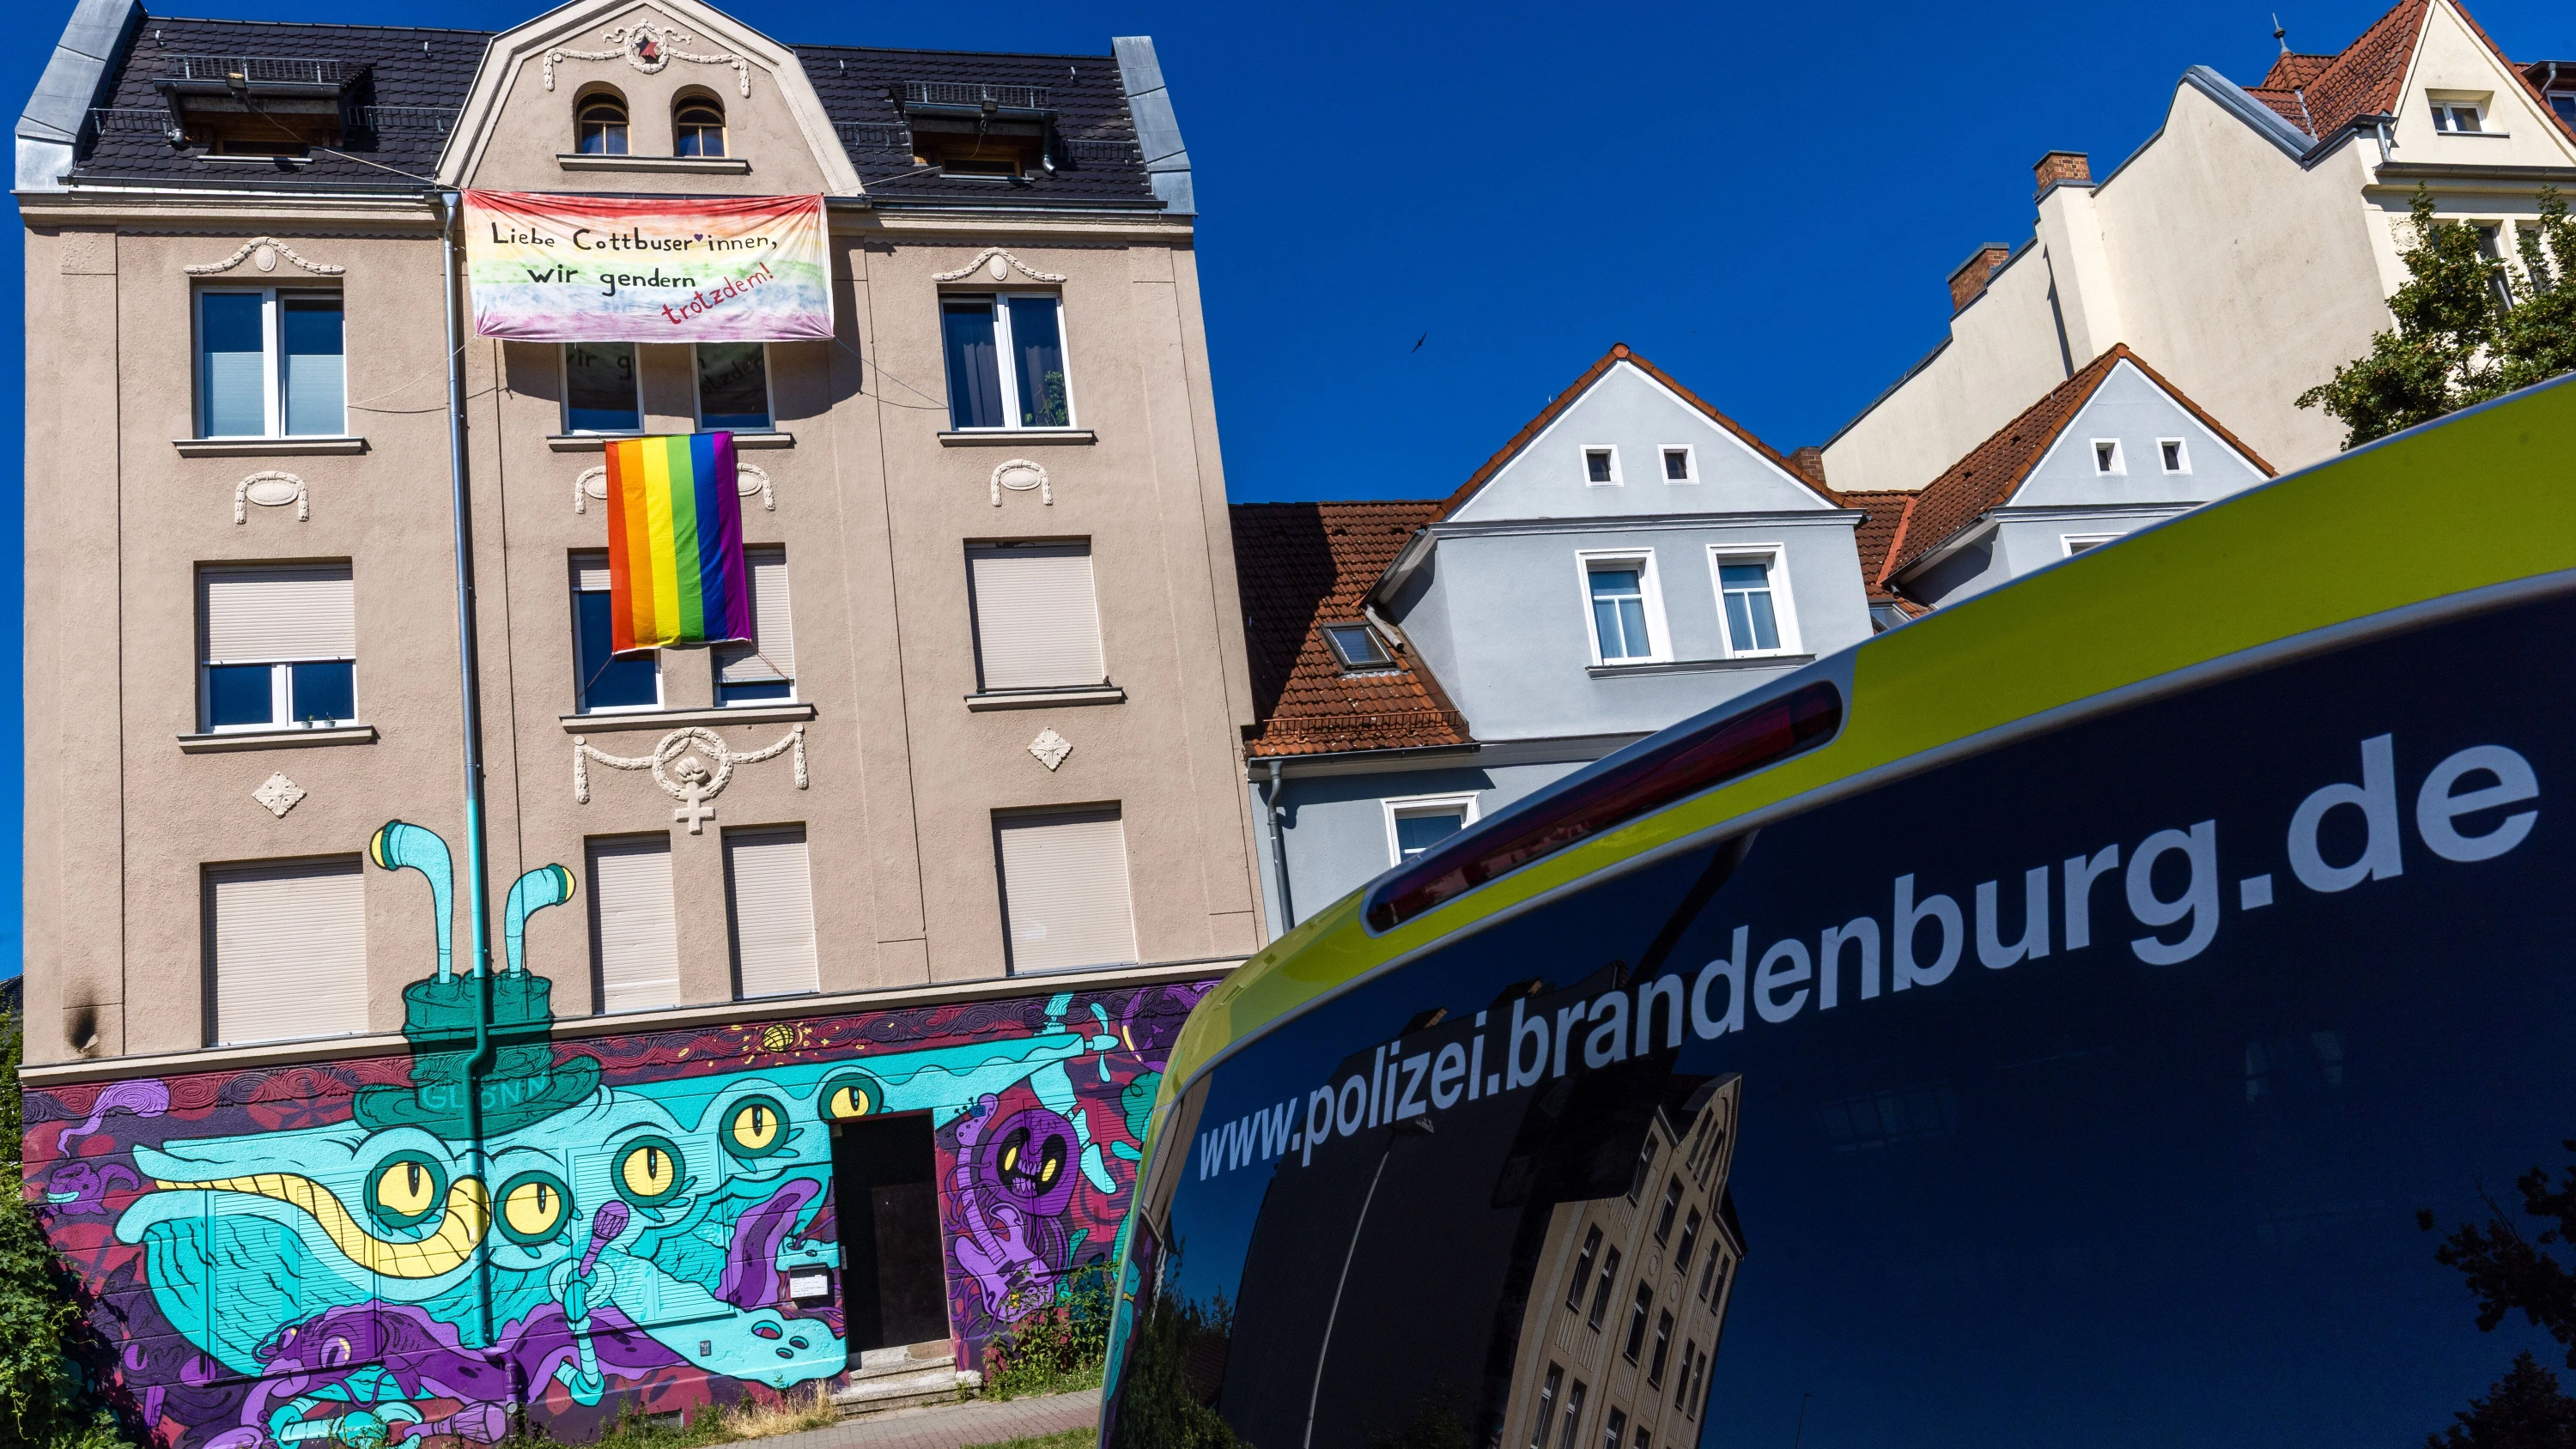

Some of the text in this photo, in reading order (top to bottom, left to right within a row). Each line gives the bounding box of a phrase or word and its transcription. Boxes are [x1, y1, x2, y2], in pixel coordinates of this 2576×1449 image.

[491, 221, 555, 247] Liebe
[527, 264, 696, 297] wir gendern
[661, 262, 774, 324] trotzdem!
[1200, 733, 2539, 1181] www.polizei.brandenburg.de
